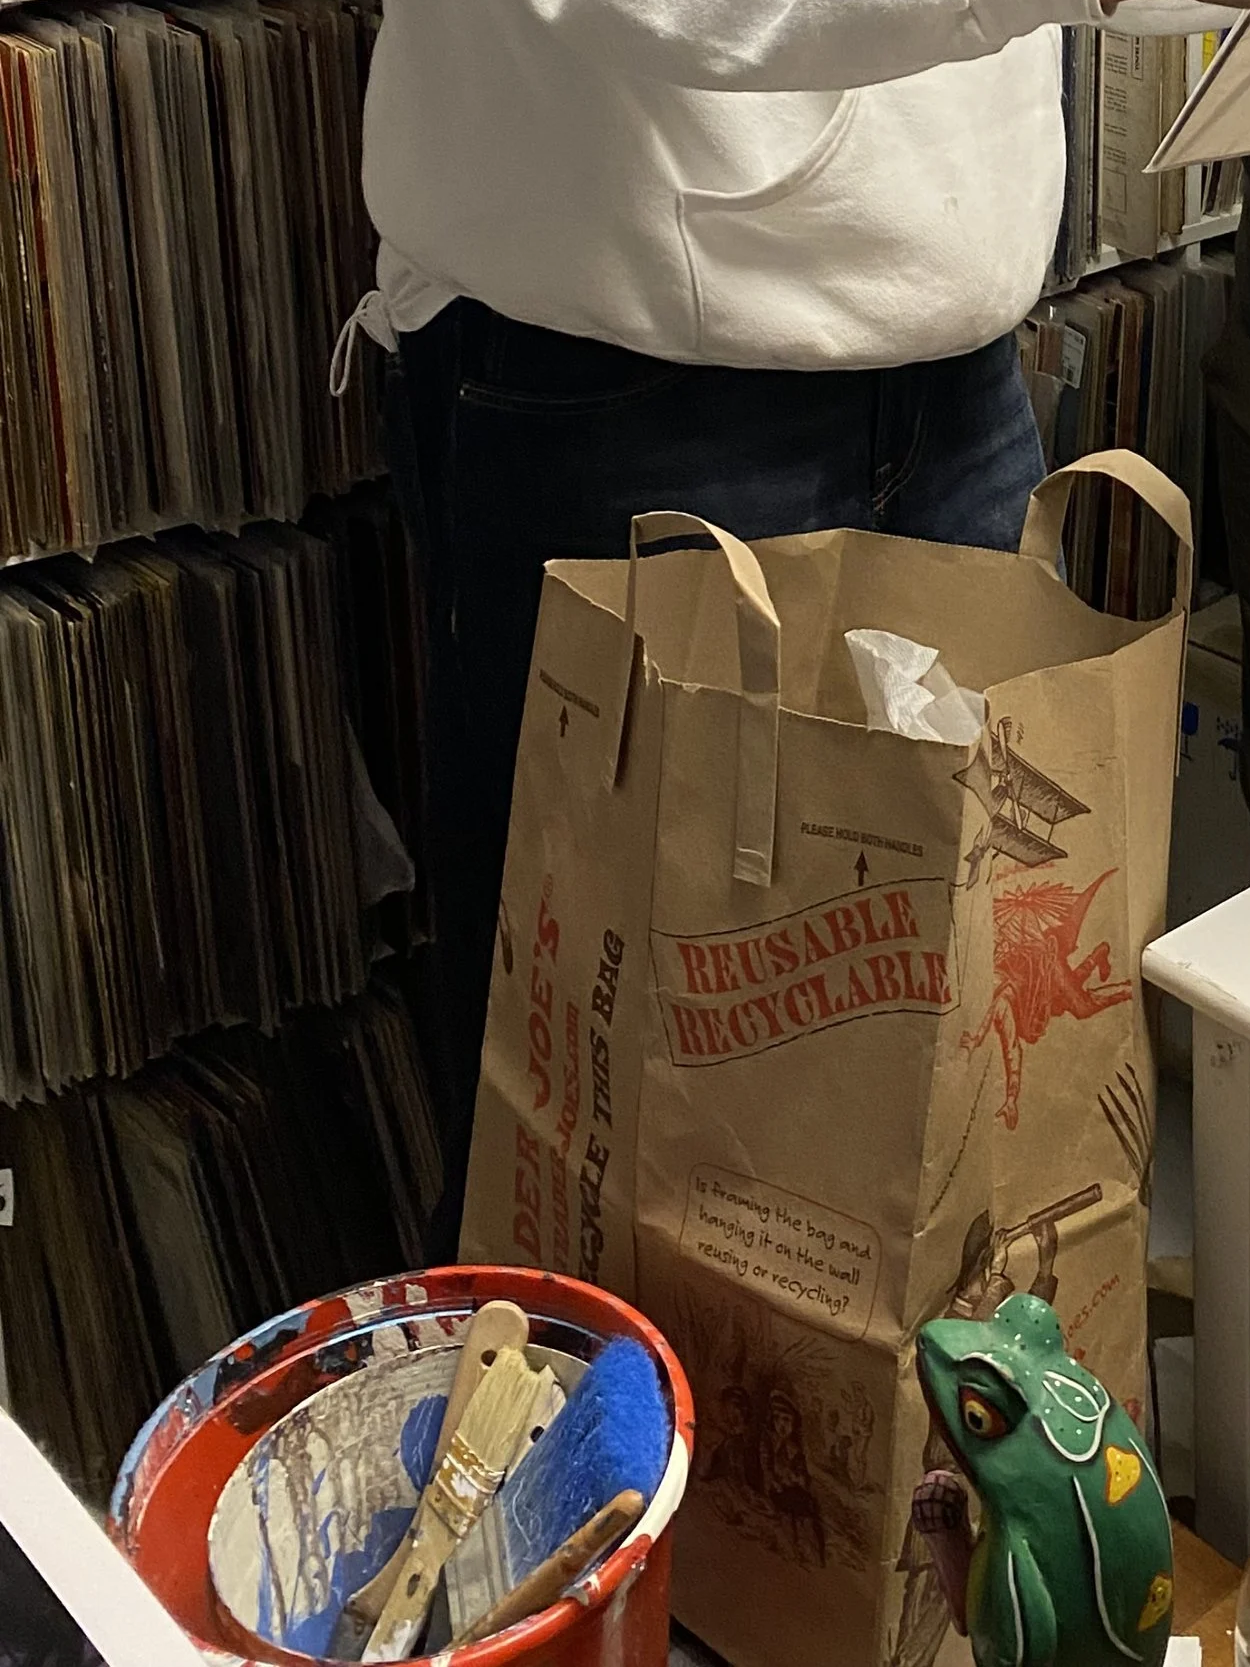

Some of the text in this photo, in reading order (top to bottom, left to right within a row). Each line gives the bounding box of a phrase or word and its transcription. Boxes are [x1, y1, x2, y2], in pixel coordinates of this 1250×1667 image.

[801, 821, 924, 857] PLEASE HOLD BOTH HANDLES
[677, 890, 920, 995] REUSABLE
[671, 950, 952, 1056] RECYCLABLE
[579, 927, 626, 1284] ECYCLE THIS BAG
[513, 1122, 542, 1264] DER
[696, 1176, 872, 1259] Is framing the bag and
[698, 1241, 850, 1316] reusing or recycling?
[699, 1205, 860, 1285] hanging it on the wall
